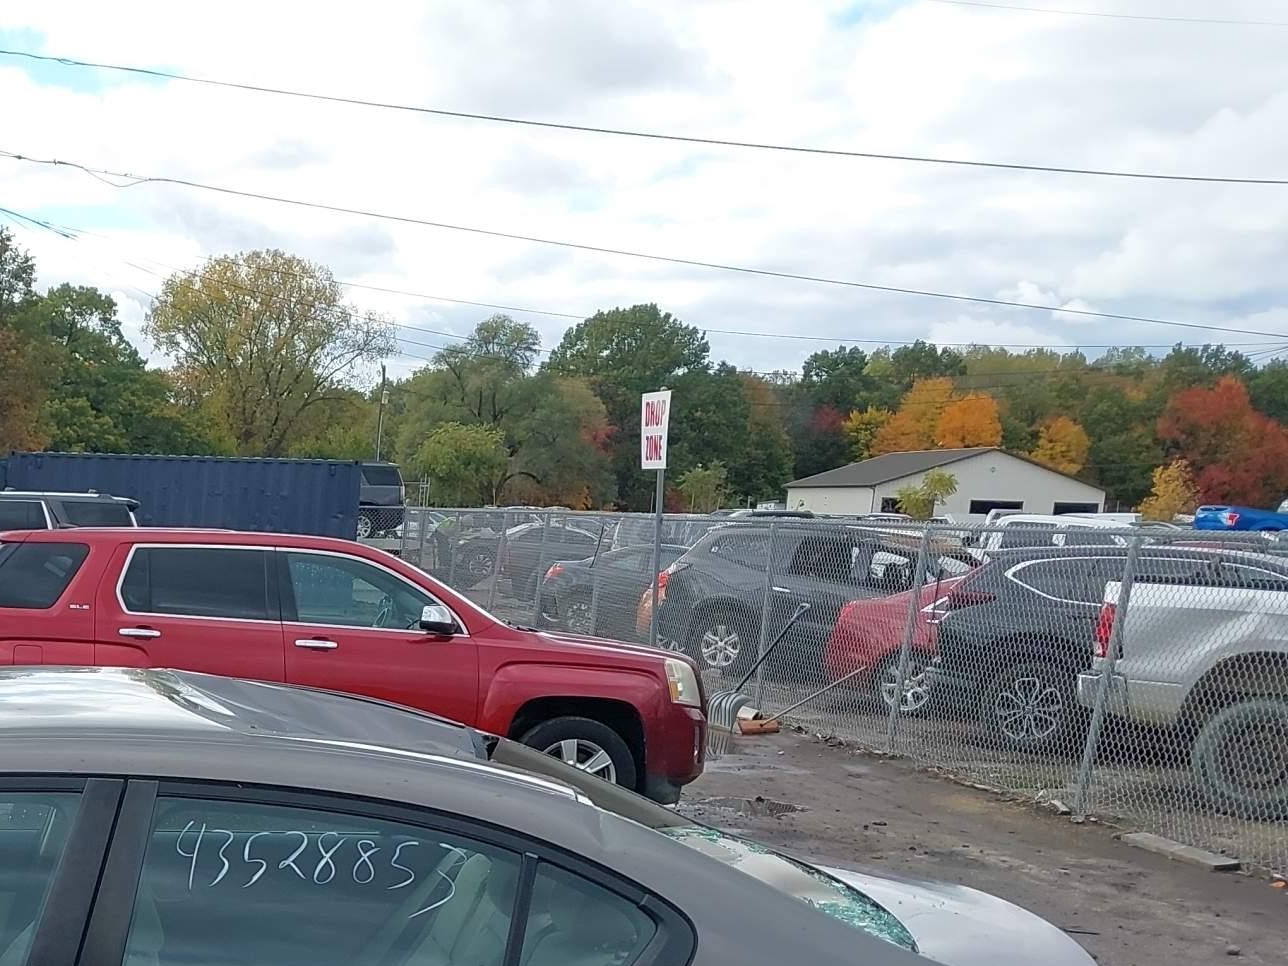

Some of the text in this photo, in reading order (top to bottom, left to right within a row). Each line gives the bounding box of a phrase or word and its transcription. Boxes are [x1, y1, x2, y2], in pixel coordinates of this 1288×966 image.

[645, 400, 666, 427] DROP
[646, 435, 662, 460] ZONE
[176, 821, 468, 918] 43528853
